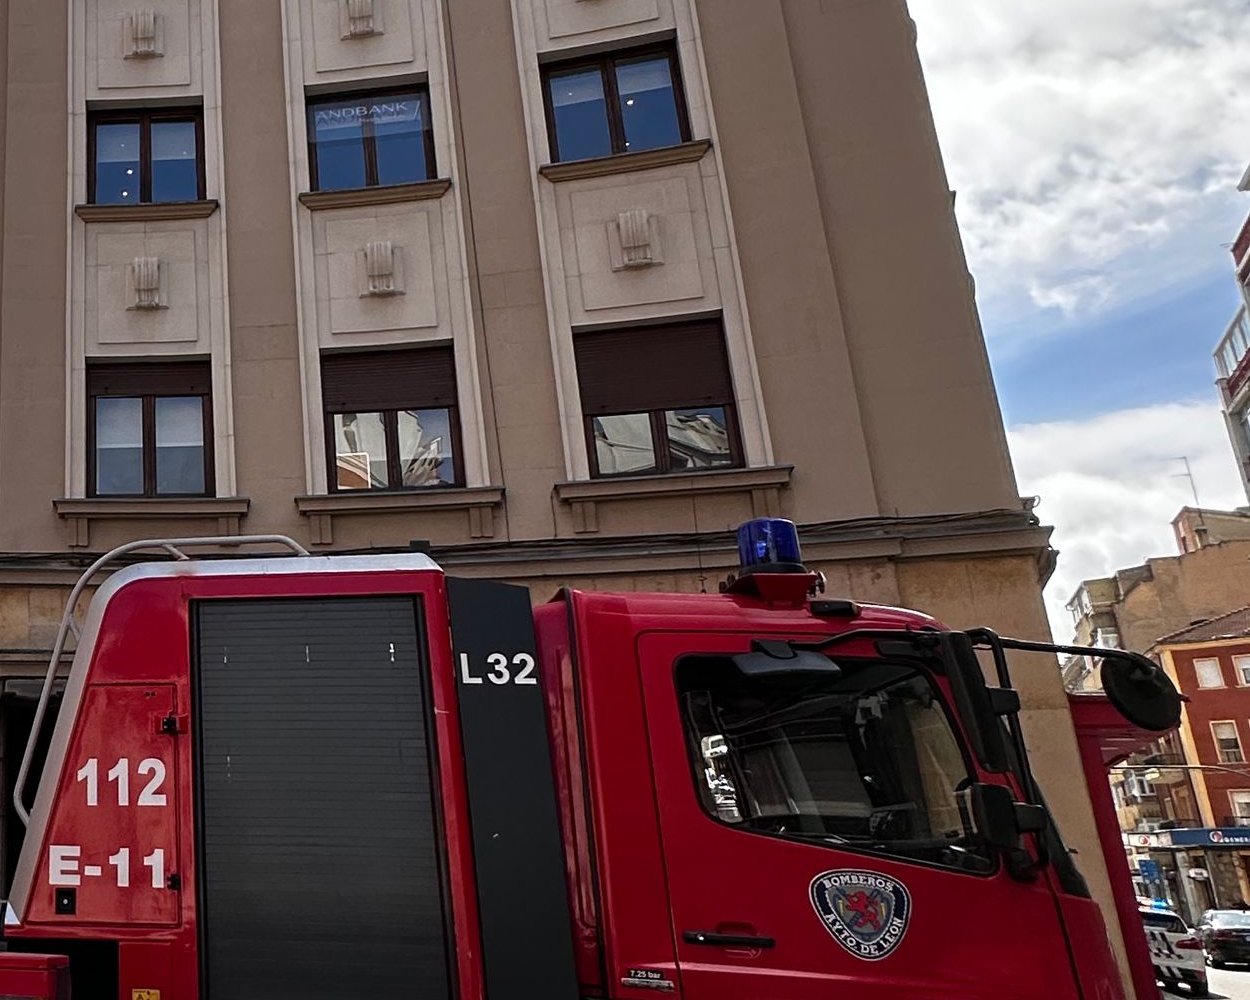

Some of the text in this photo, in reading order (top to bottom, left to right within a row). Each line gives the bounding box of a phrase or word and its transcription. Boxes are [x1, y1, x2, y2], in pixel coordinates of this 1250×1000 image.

[316, 102, 408, 120] ANDBANK
[459, 652, 537, 685] L32
[77, 758, 167, 806] 112
[49, 845, 165, 888] E-11
[823, 875, 894, 892] BOMBEROS
[860, 944, 879, 955] DE
[648, 971, 661, 979] bar
